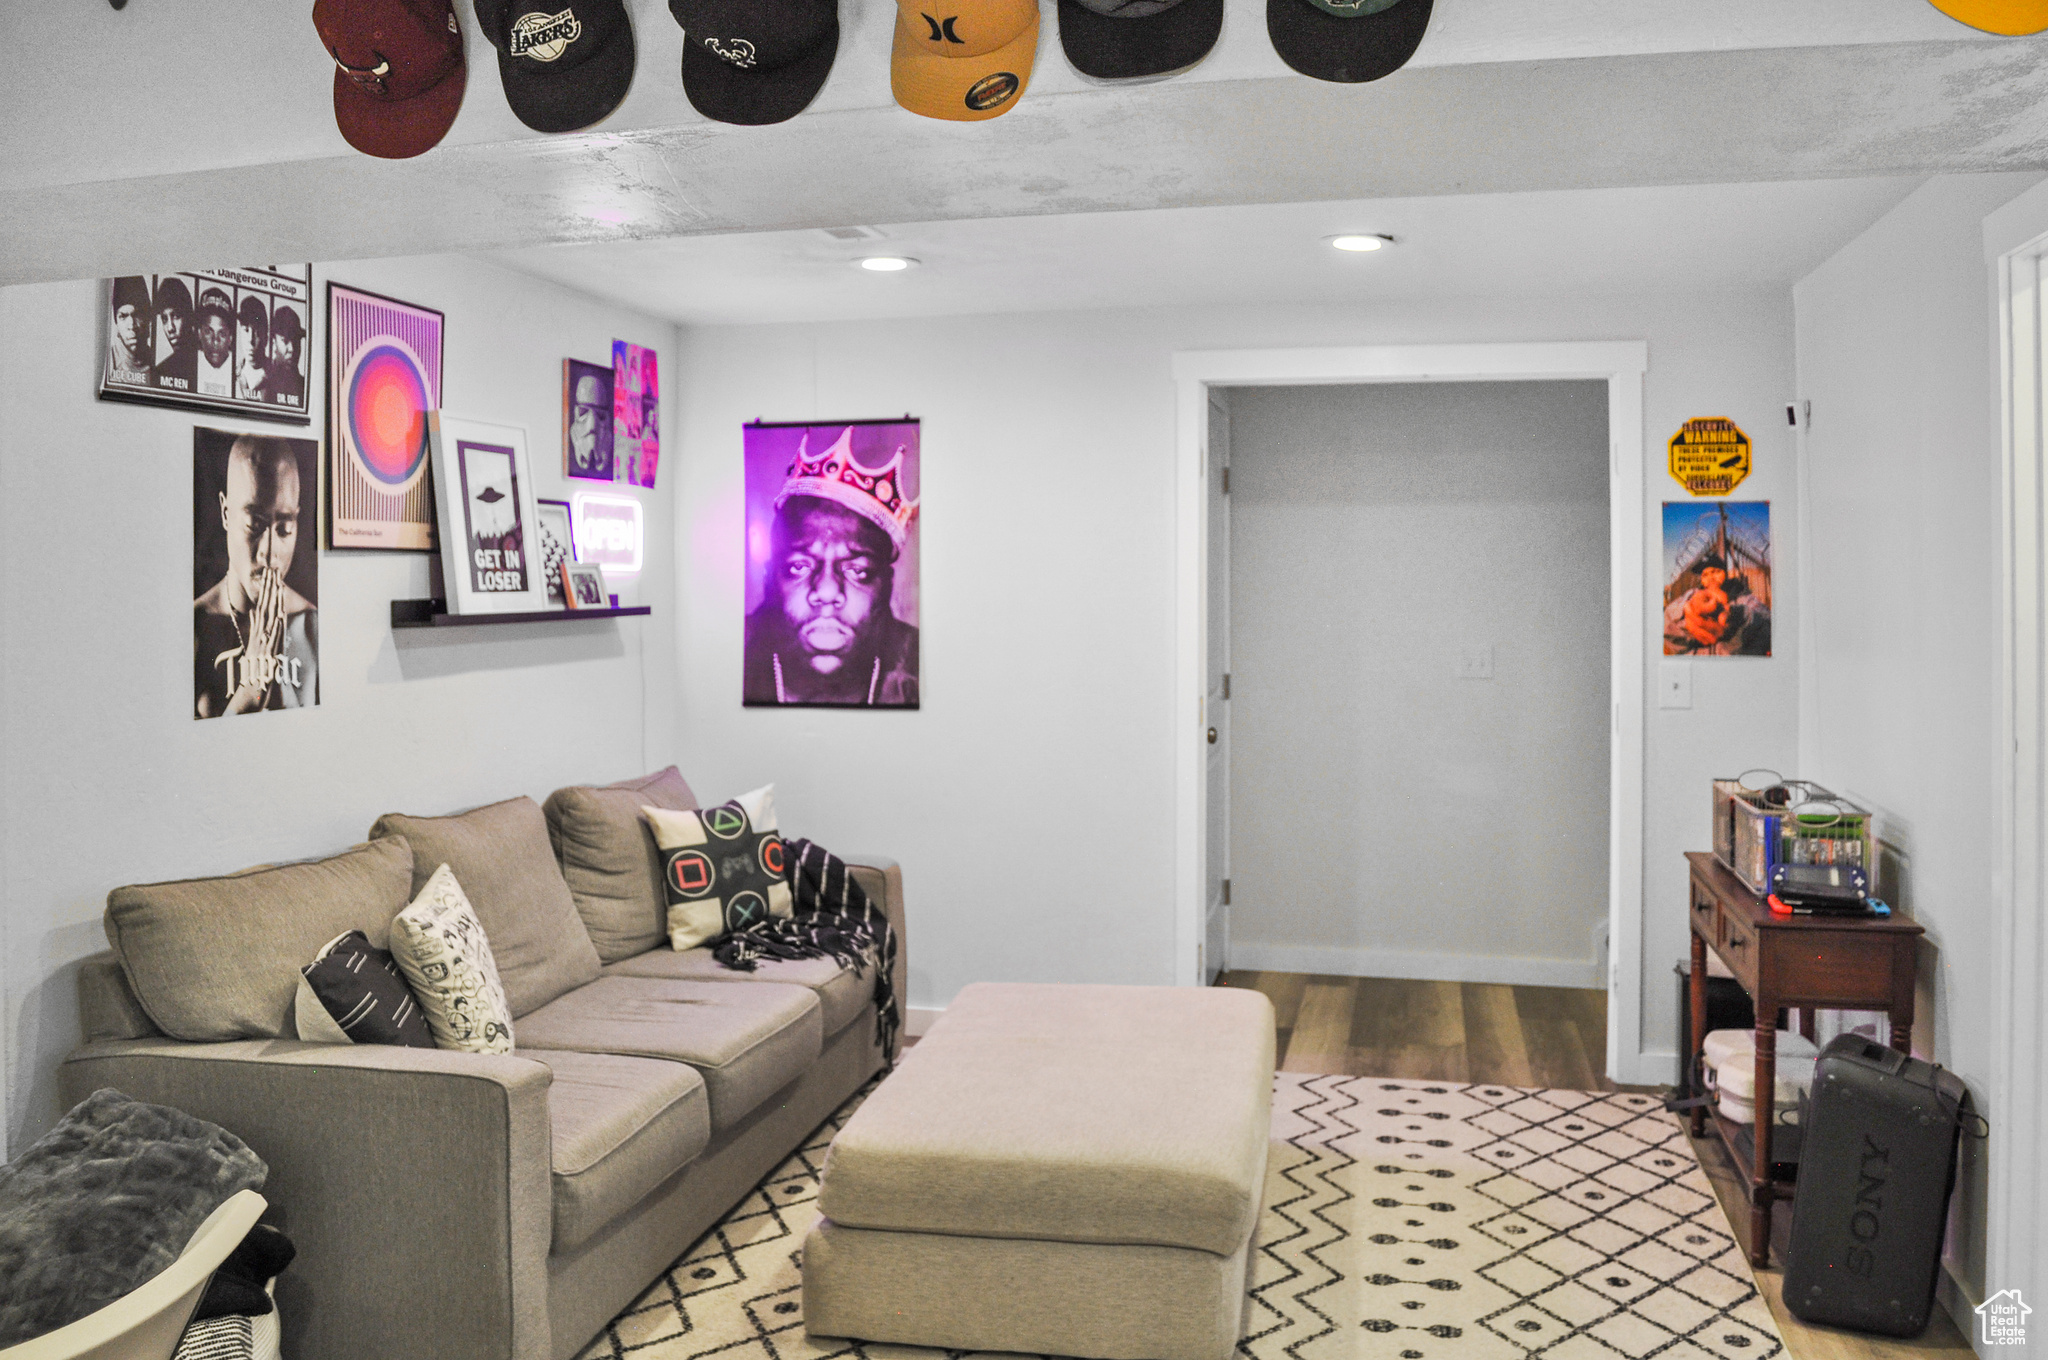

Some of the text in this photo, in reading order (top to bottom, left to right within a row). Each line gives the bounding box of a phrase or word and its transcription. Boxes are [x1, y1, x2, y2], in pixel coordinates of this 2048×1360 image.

[512, 19, 579, 53] LAKERS
[218, 269, 267, 287] Dangerous
[270, 279, 297, 297] Group
[128, 372, 147, 384] CUBE
[160, 375, 189, 390] MC REN
[1684, 430, 1737, 443] WARNING
[583, 517, 635, 551] OPEN
[475, 549, 521, 570] GET IN
[477, 571, 522, 592] LOSER
[1846, 1134, 1890, 1279] SONY
